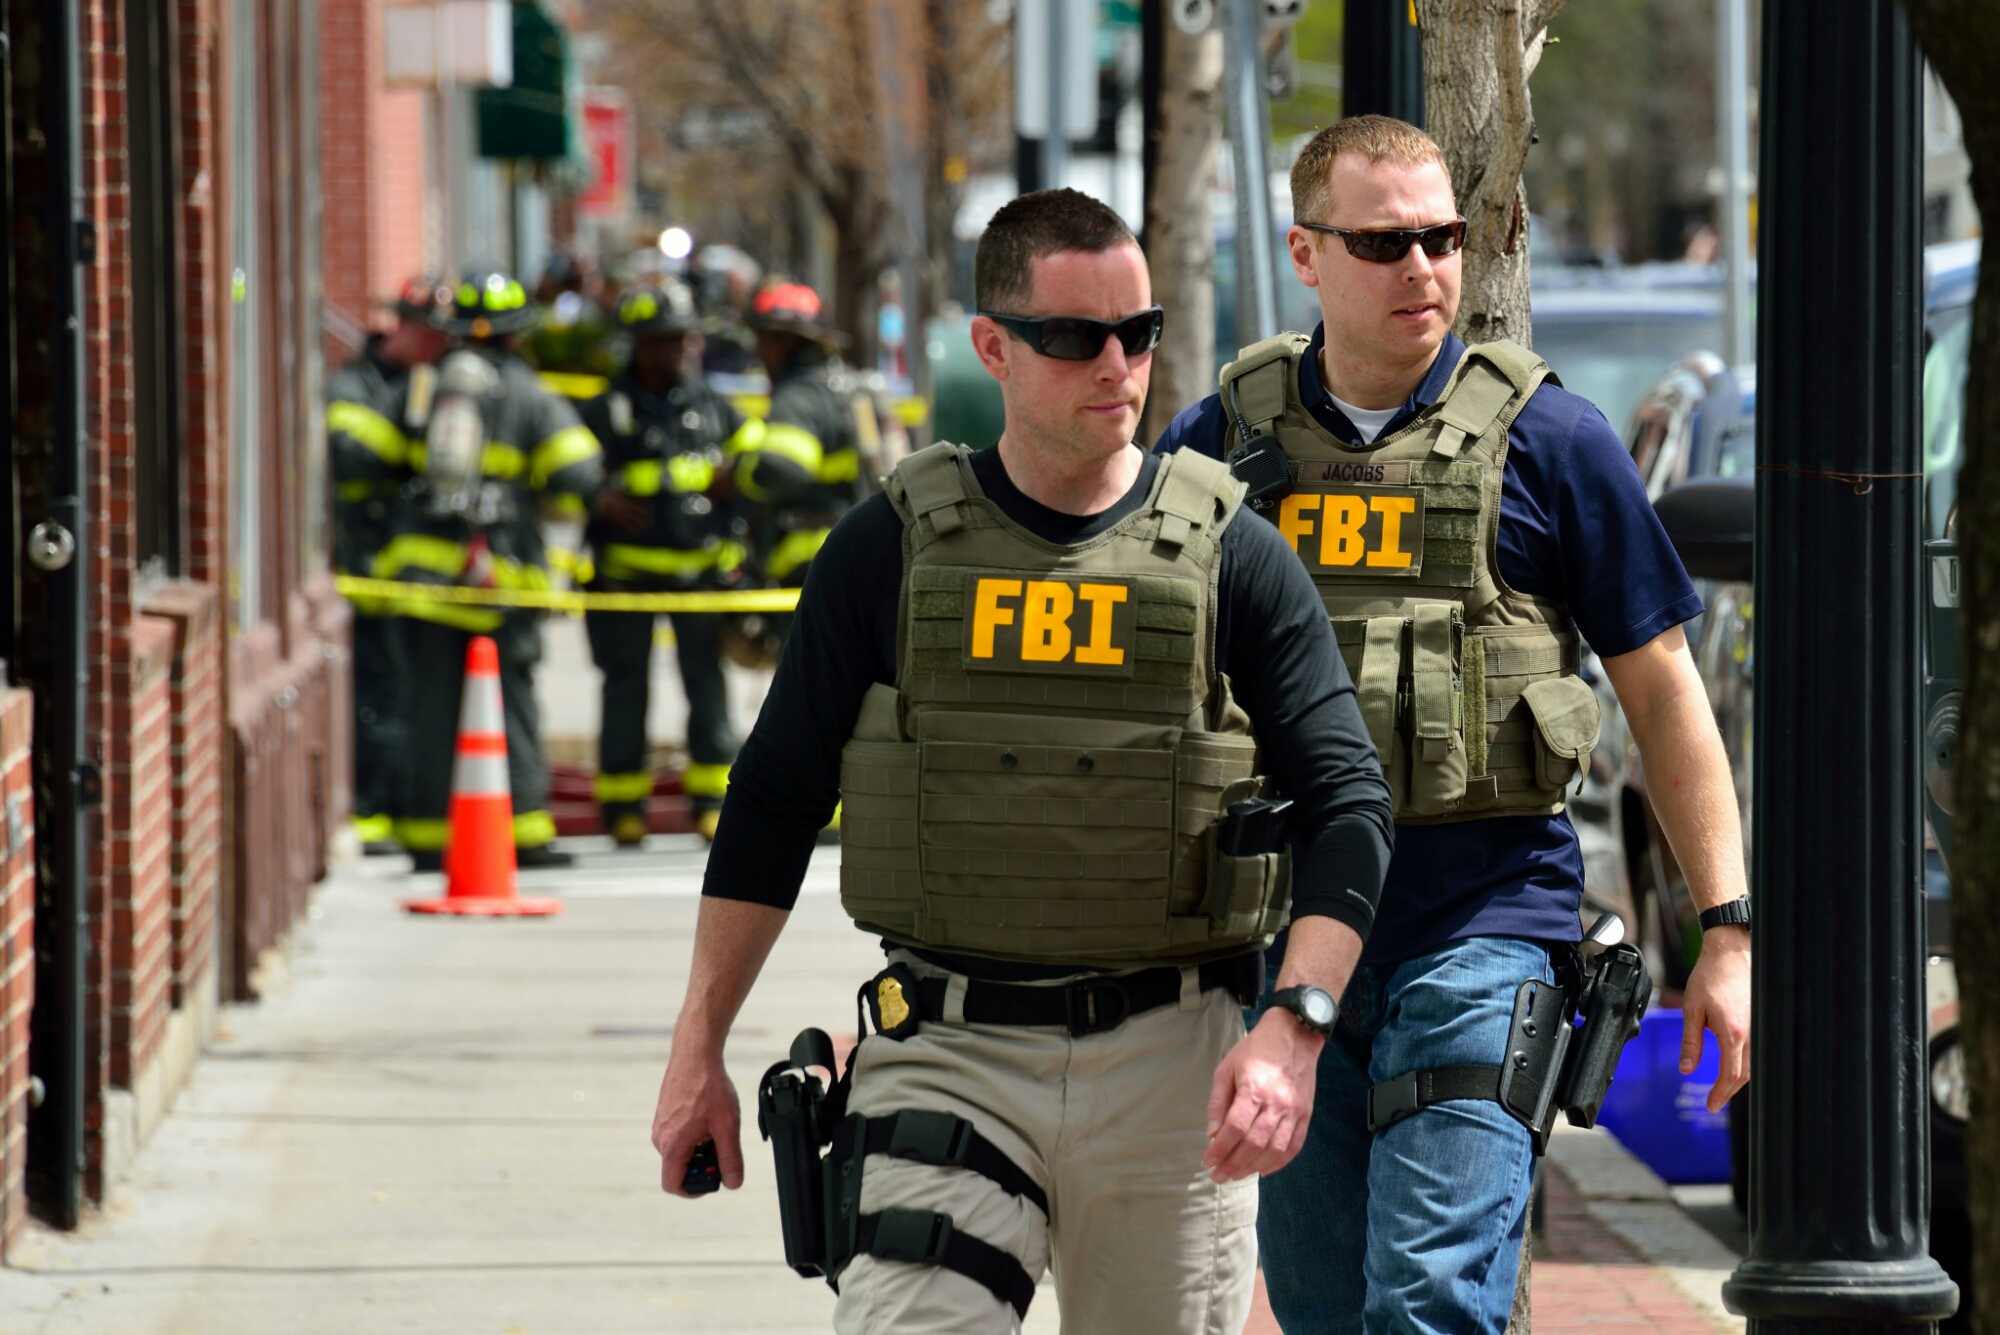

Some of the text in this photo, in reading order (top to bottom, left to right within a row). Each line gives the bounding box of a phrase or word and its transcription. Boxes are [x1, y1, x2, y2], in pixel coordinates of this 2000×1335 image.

[1322, 464, 1385, 482] JACOBS
[1279, 494, 1415, 568] FBI
[971, 578, 1129, 665] FBI
